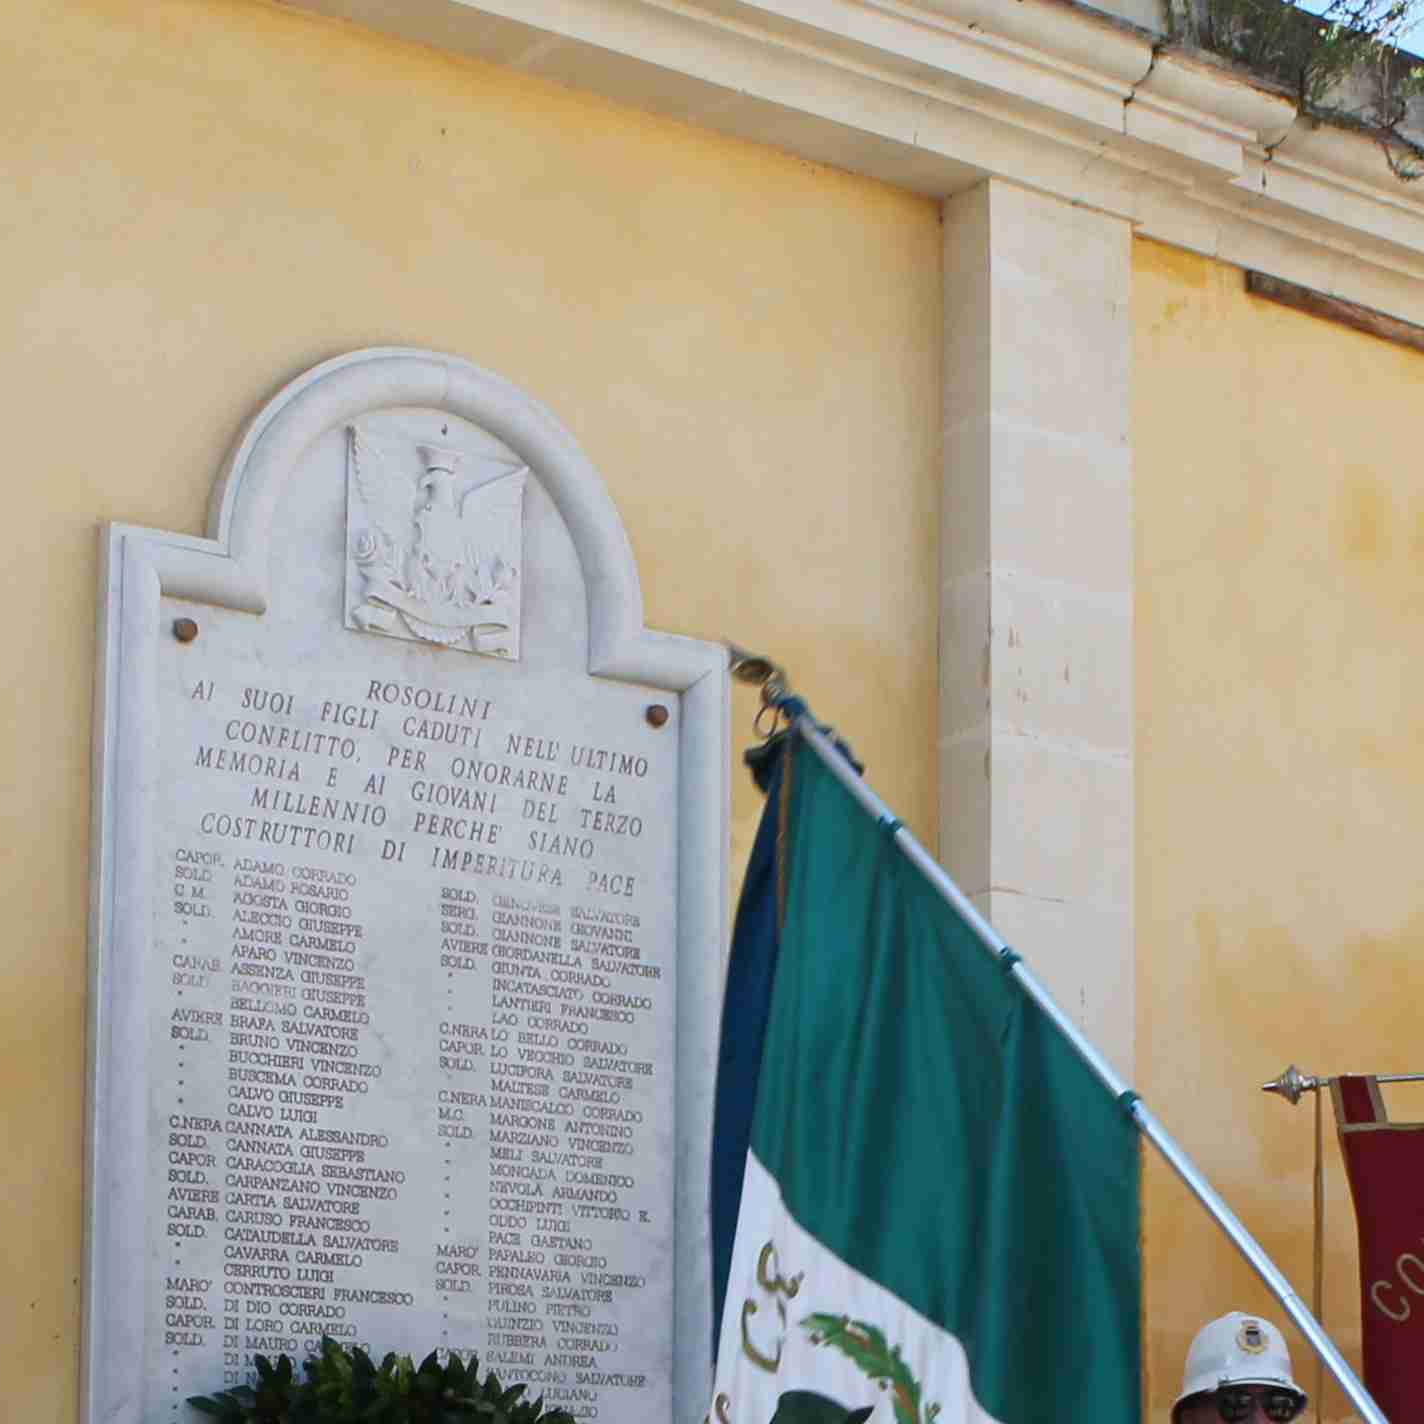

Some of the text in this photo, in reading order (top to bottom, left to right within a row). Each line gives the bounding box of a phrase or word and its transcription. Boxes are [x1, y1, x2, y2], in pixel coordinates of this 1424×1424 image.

[366, 680, 491, 720] ROSOLINI
[191, 680, 214, 701] AI
[241, 688, 293, 717] SUOI
[320, 701, 378, 730] FIGLI
[402, 716, 481, 750] CADUTI
[568, 745, 648, 778] ULTIMO
[387, 745, 426, 773] PER
[447, 756, 568, 796] ONORARNE
[591, 780, 615, 804] LA
[195, 746, 642, 837] MEMORIA E AI GIOVANI DEL TERZO
[250, 787, 386, 827] MILLENNIO
[528, 830, 594, 859] SIANO
[200, 813, 635, 897] COSTRUTTORI DI IMPERITURA PACE
[284, 951, 355, 972] VINCENZO
[281, 1020, 359, 1041] SALVATORE
[230, 1032, 358, 1058] BRUNO VINCENZO
[311, 1057, 382, 1078] VINCENZO
[228, 1067, 368, 1093] BUSCEMA CORRADO
[227, 1085, 274, 1103] CALVO
[227, 1103, 318, 1124] CALVO LUIGI
[225, 1120, 293, 1139] CANNATA
[298, 1128, 389, 1148] ALESSANDRO
[321, 1164, 406, 1185] SEBASTIANO
[327, 1182, 398, 1201] VINCENZO
[283, 1196, 360, 1215] SALVATORE
[225, 1210, 282, 1226] CARUSO
[289, 1214, 370, 1234] FRANCESCO
[322, 1234, 399, 1253] SALVATORE
[224, 1245, 363, 1267] CAVARRA CARMELO
[297, 1268, 334, 1283] LUIGI
[334, 1288, 413, 1306] FRANCESCO
[224, 1299, 239, 1313] DI
[246, 1301, 271, 1314] DIO
[279, 1303, 346, 1319] CORRADO
[224, 1317, 239, 1330] DI
